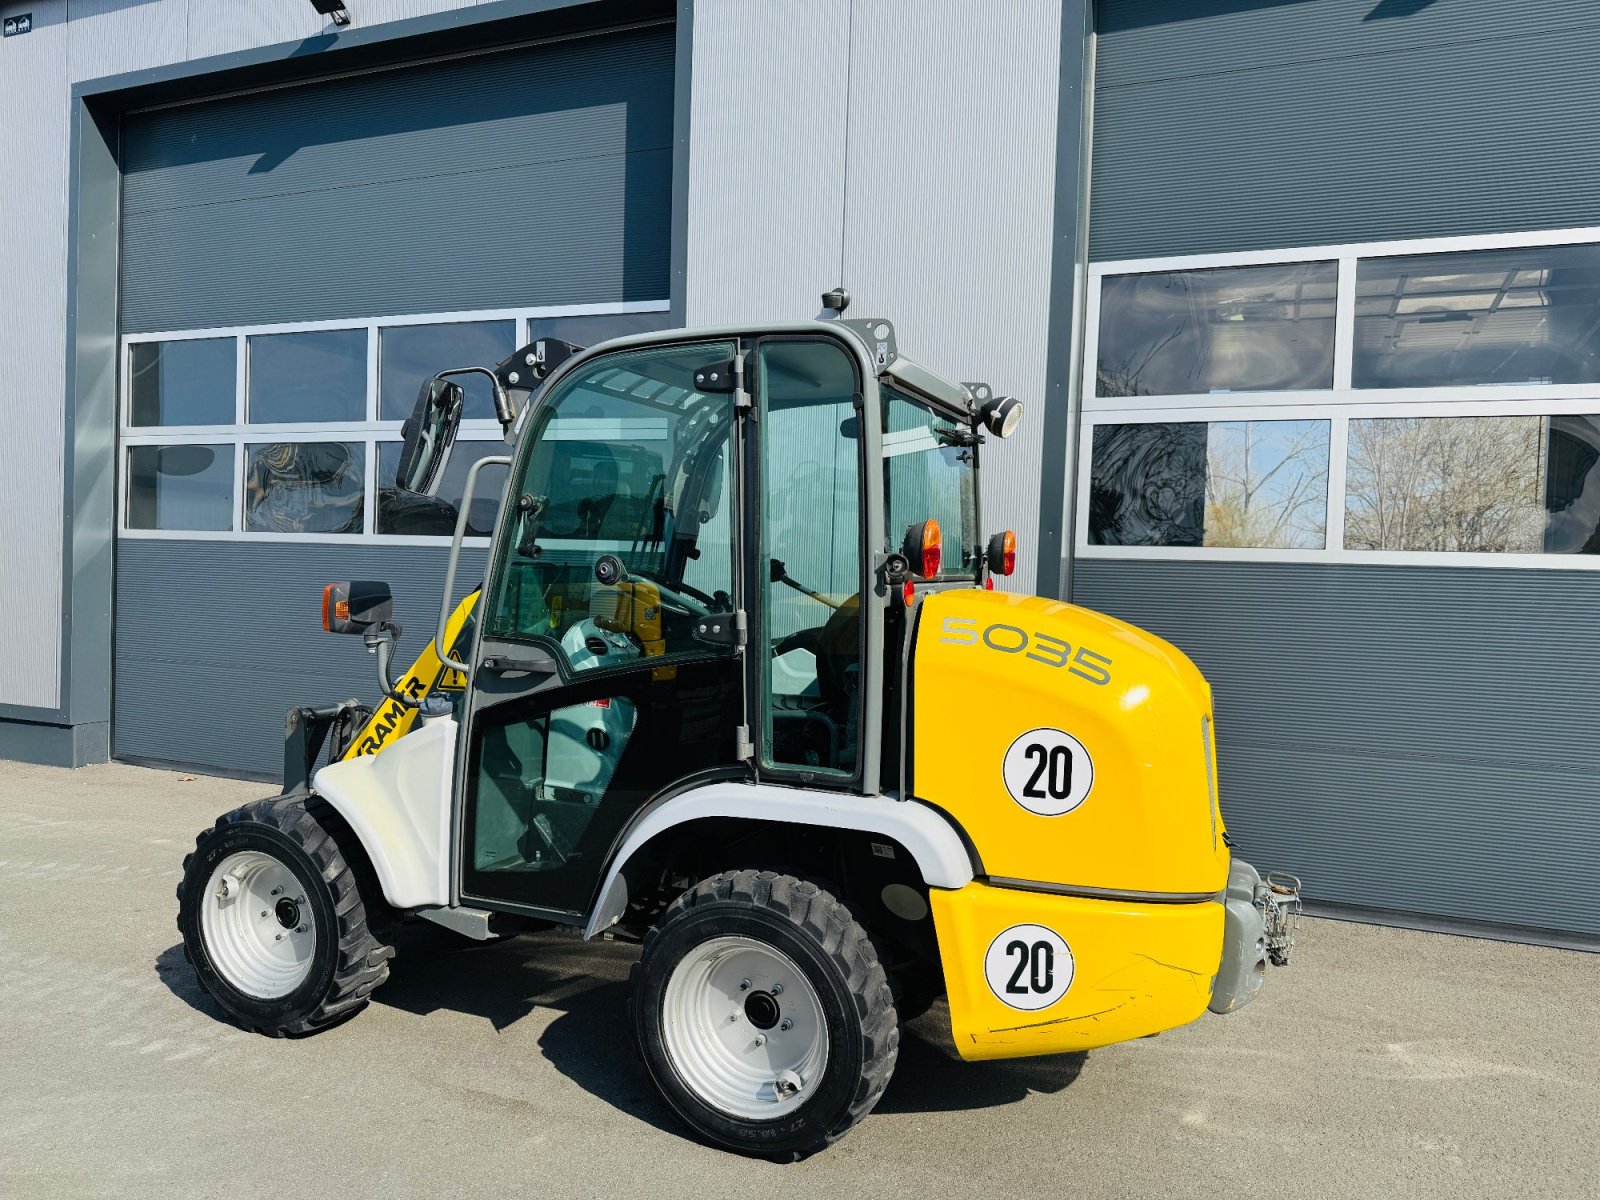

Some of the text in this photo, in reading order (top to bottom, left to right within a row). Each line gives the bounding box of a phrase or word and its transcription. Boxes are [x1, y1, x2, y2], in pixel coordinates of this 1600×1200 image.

[939, 617, 1112, 686] 5035
[355, 676, 427, 757] RAMR
[1023, 743, 1073, 800] 20
[1006, 940, 1053, 994] 20
